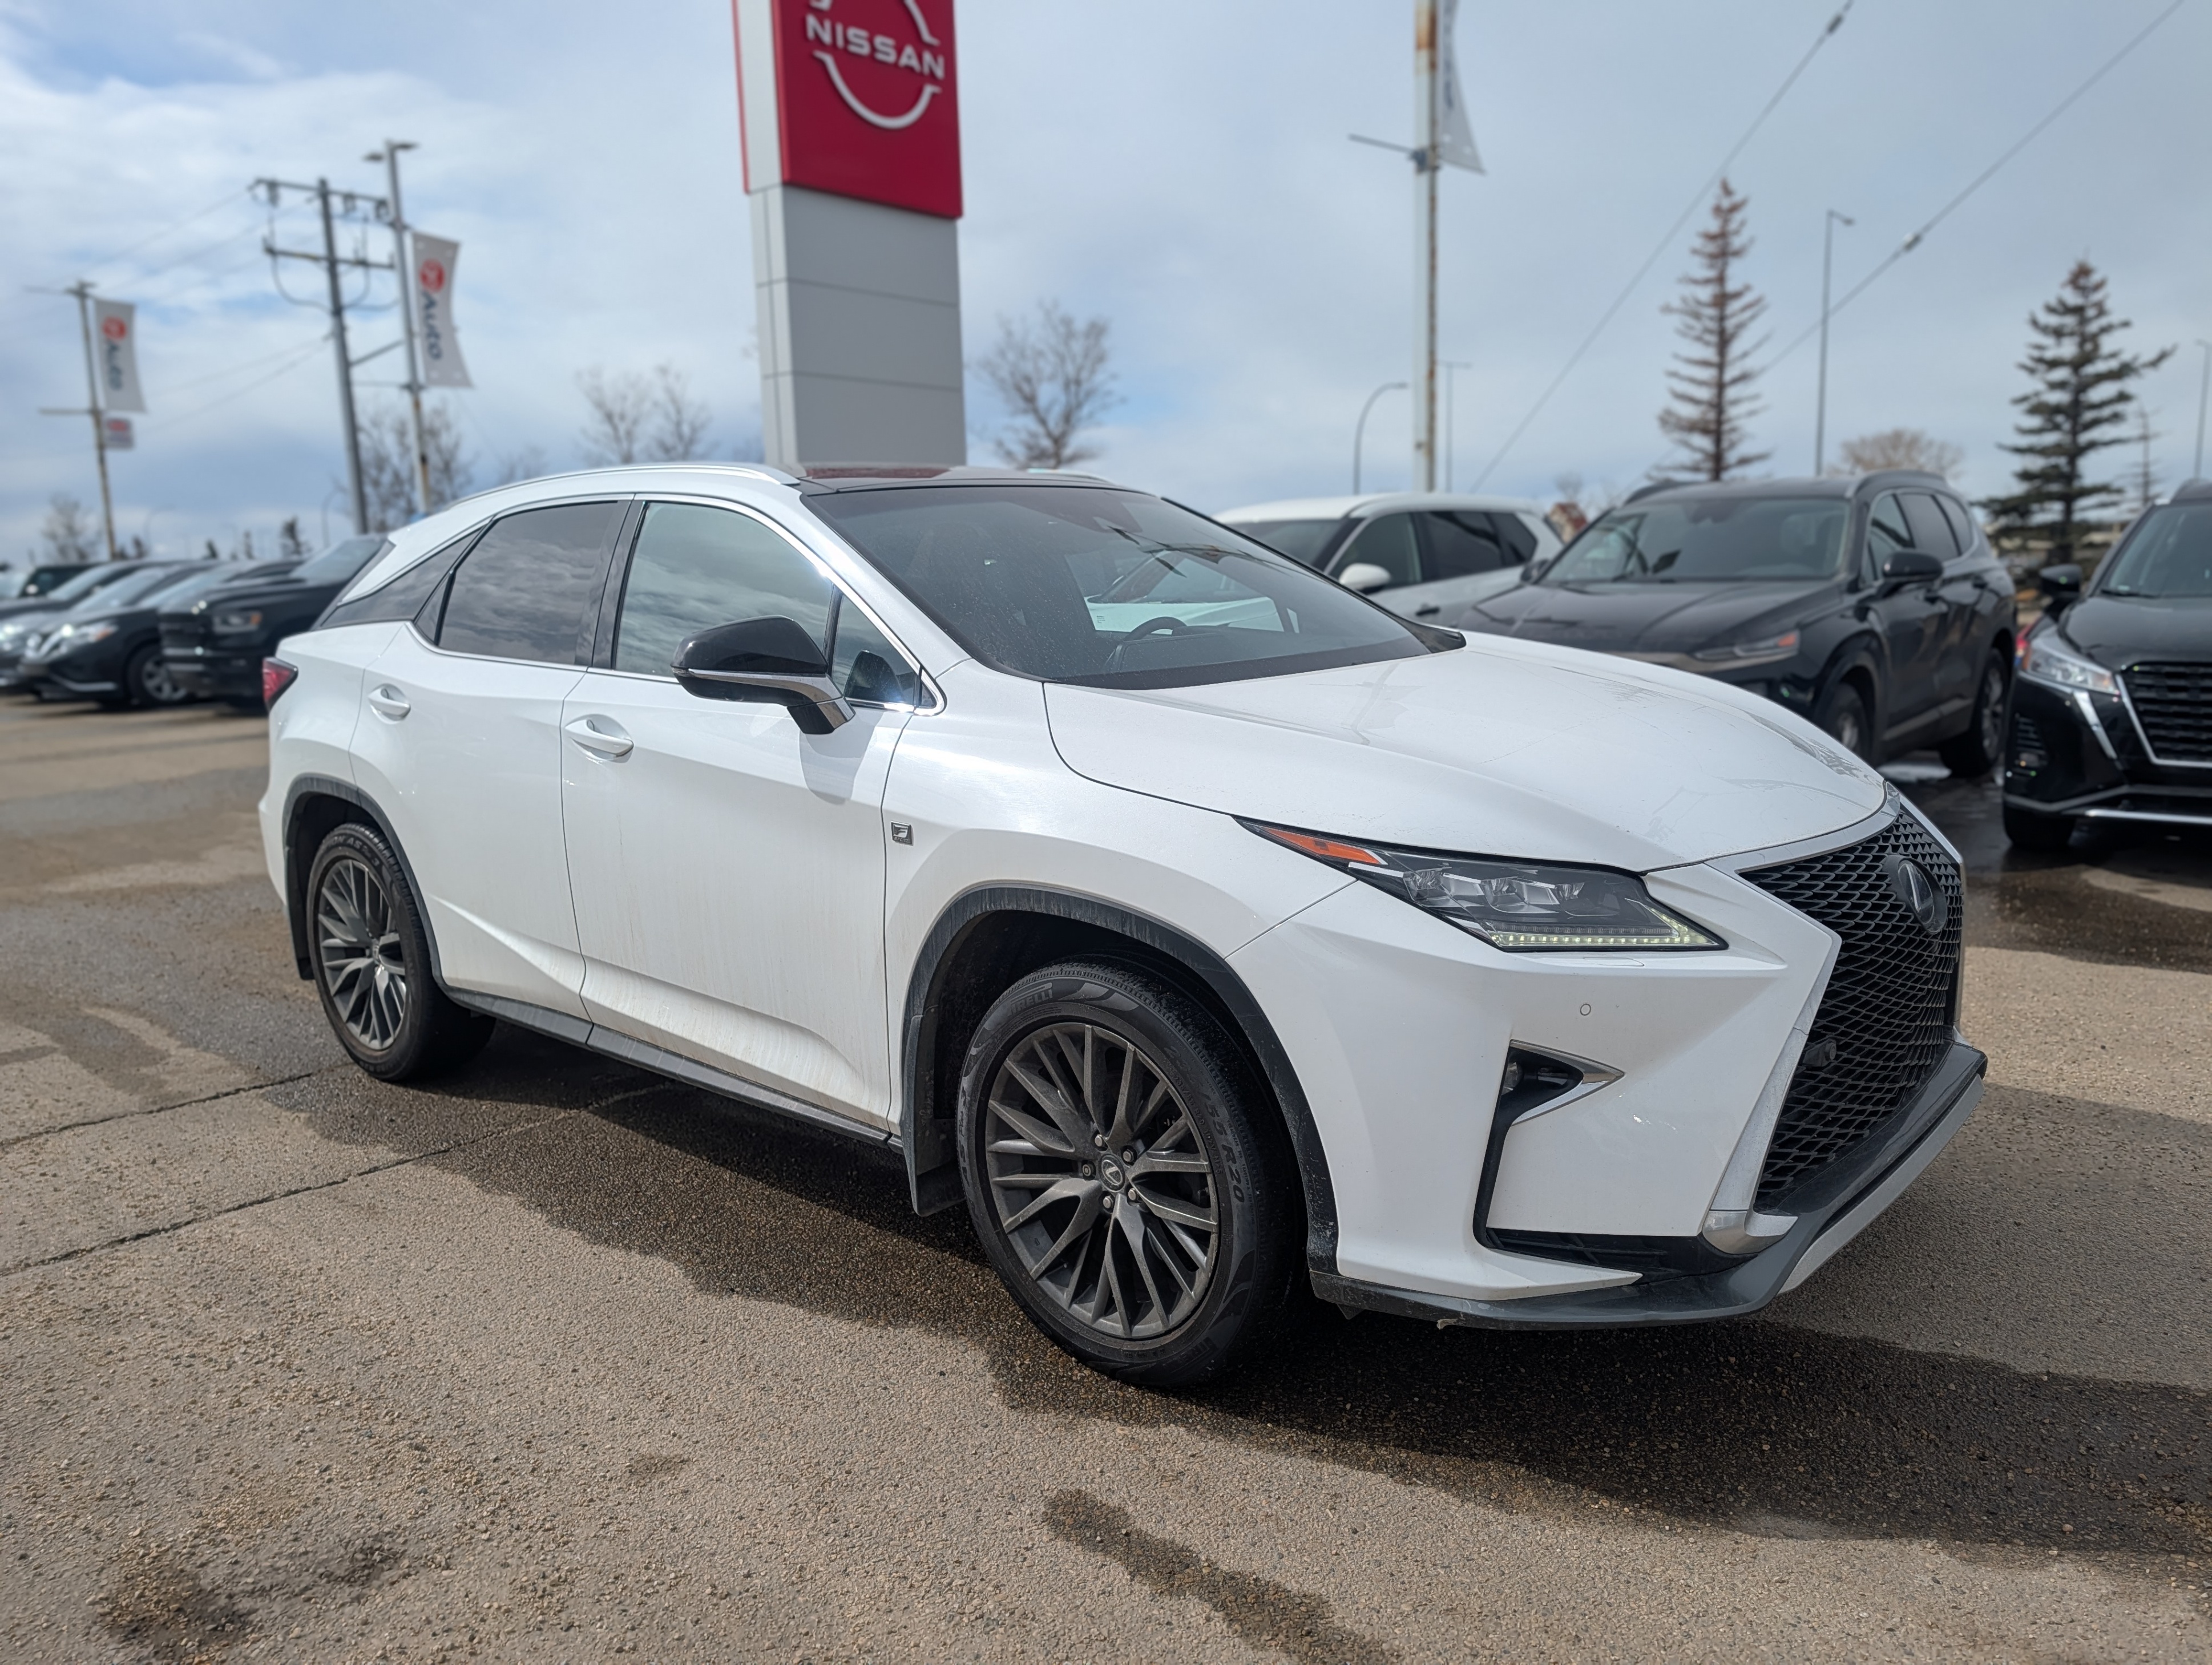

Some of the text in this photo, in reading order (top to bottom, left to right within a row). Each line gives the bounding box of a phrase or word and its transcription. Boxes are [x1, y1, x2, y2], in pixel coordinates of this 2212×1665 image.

[806, 13, 945, 80] NISSAN
[1010, 982, 1053, 1015] PIRELLI
[1221, 1143, 1245, 1203] R20
